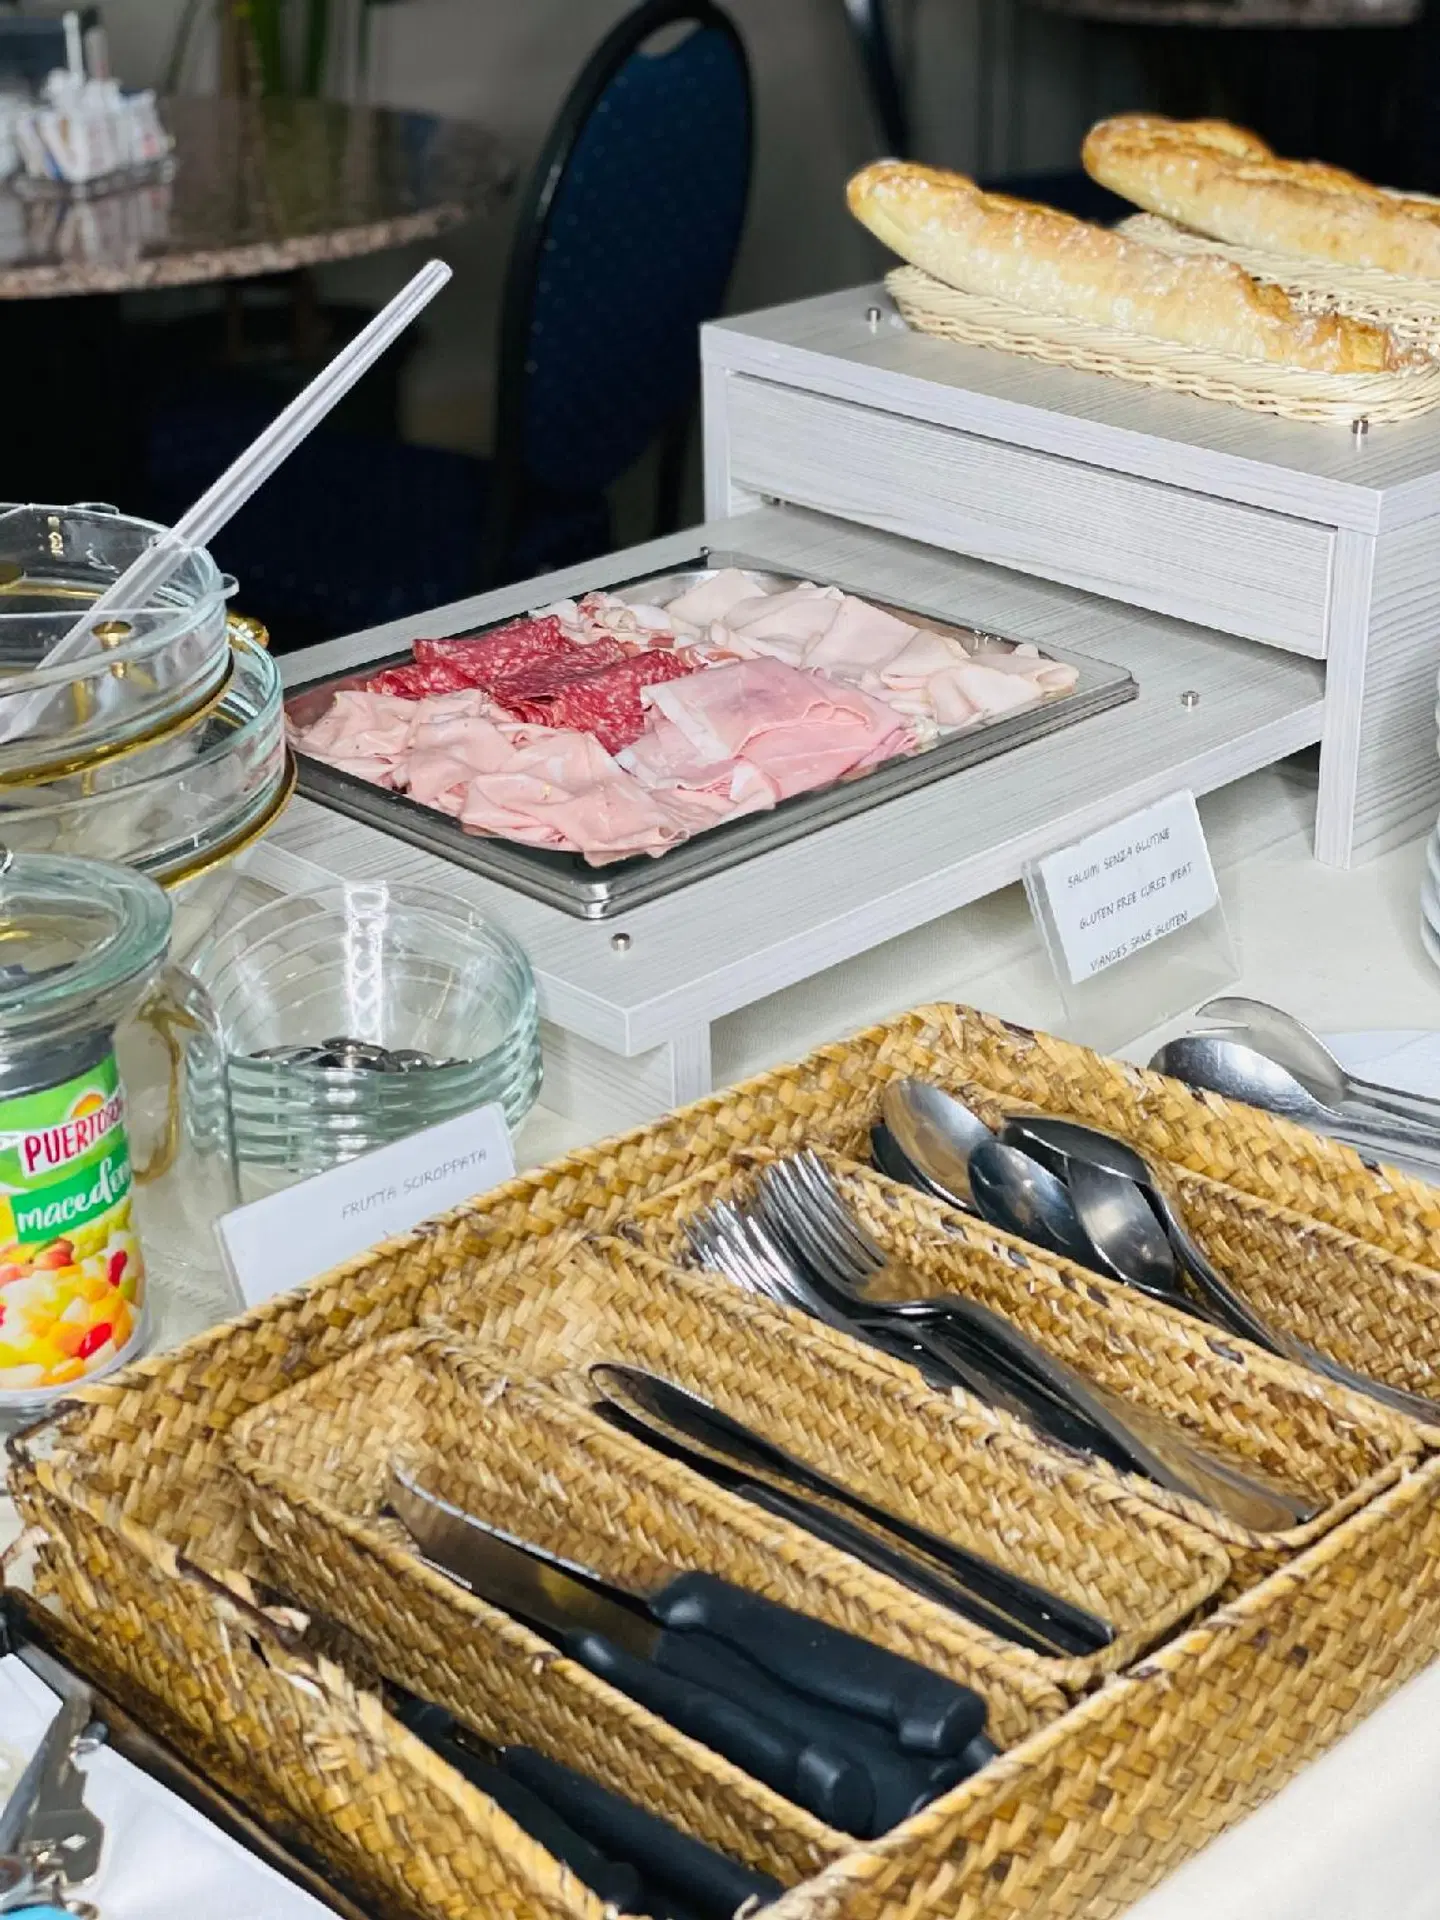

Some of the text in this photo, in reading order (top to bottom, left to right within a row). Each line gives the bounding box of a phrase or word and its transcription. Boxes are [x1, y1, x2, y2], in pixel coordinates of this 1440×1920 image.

[1067, 827, 1170, 888] SALUMI SENZA GLUTINE
[1079, 861, 1193, 930] GLUTEN FREE CURED MEAT
[1090, 910, 1188, 972] VIANDES SANS GLUTEN
[341, 1149, 487, 1219] FRUTTA SCIROPPATA
